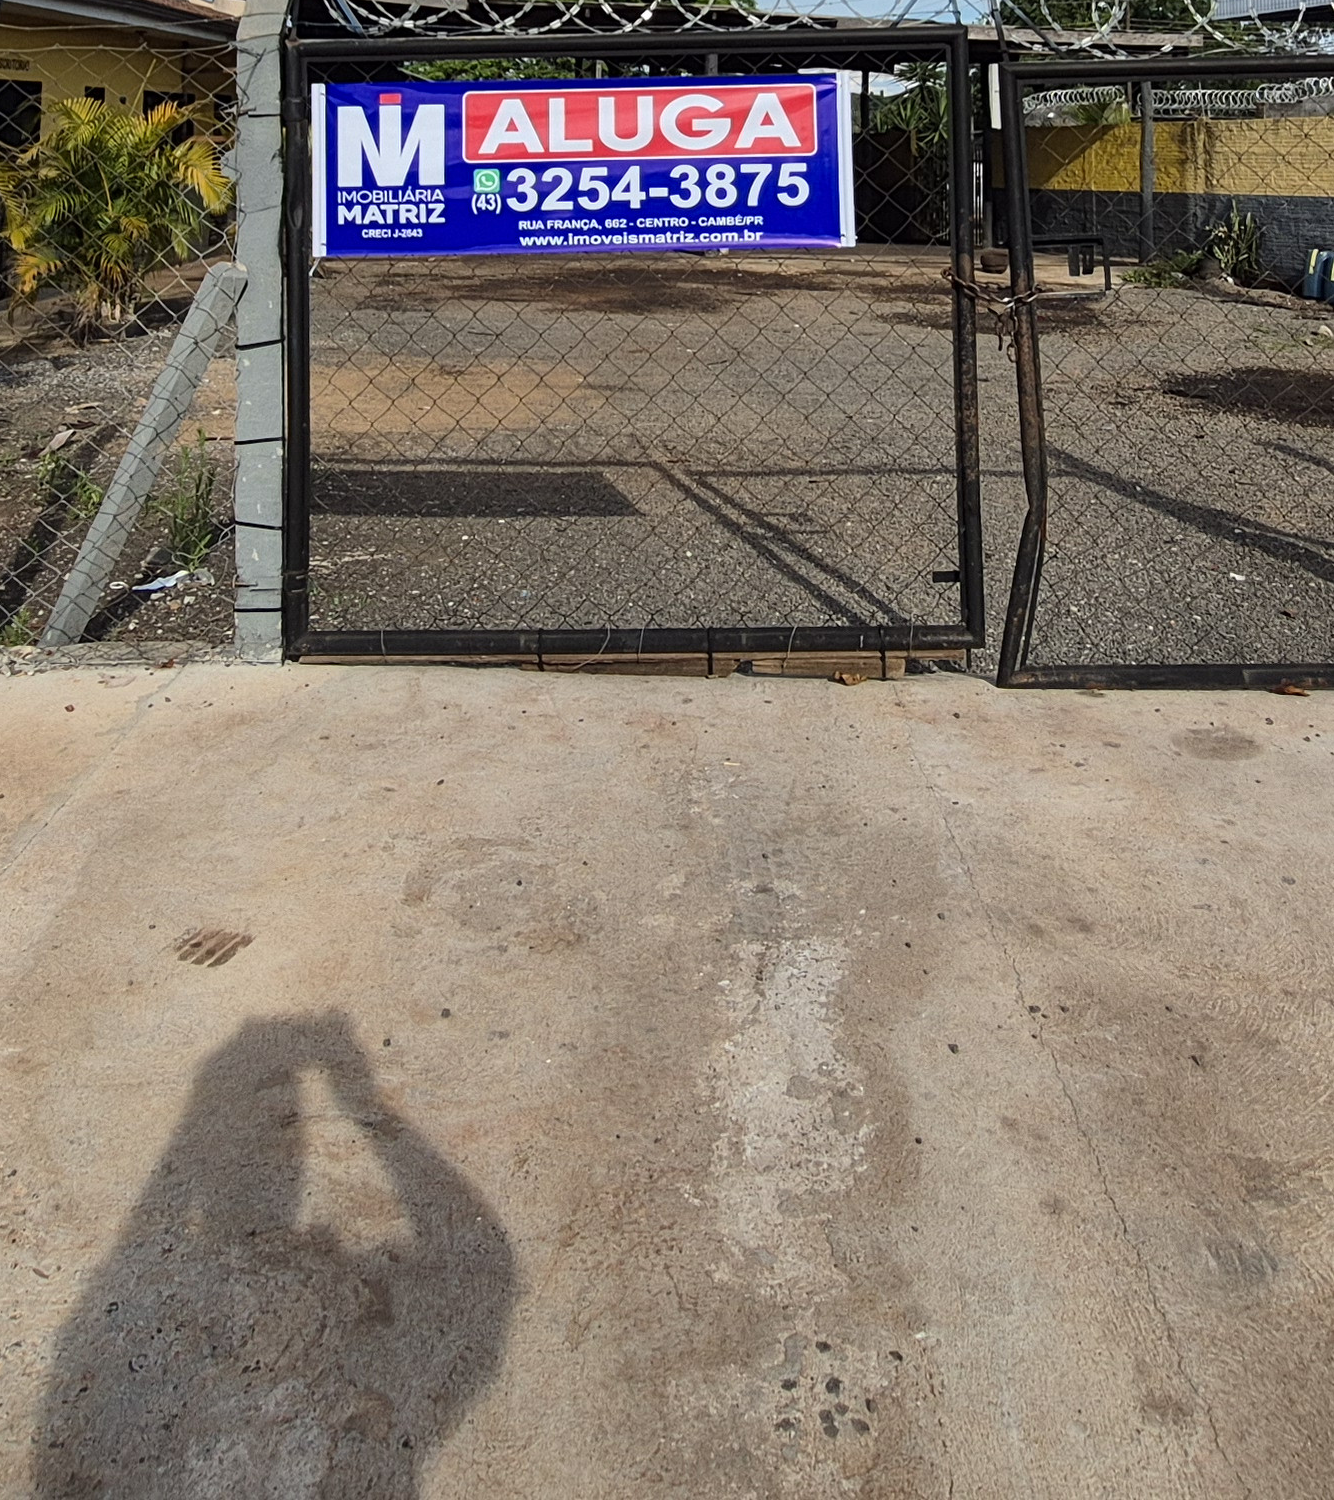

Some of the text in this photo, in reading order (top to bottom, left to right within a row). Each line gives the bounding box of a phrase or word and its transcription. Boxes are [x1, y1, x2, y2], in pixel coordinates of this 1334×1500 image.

[478, 93, 802, 155] ALUGA
[337, 186, 445, 204] IMOBILIÁRIA
[471, 162, 810, 215] (43) 3254-3875
[337, 203, 446, 225] MATRIZ
[518, 220, 545, 230] RUA
[547, 219, 602, 231] FRANÇA,
[636, 217, 689, 228] CENTRO
[698, 214, 764, 227] CAMBÉ/PR
[362, 229, 392, 238] CRECI
[519, 229, 764, 246] www.imoveismatriz.com.br
